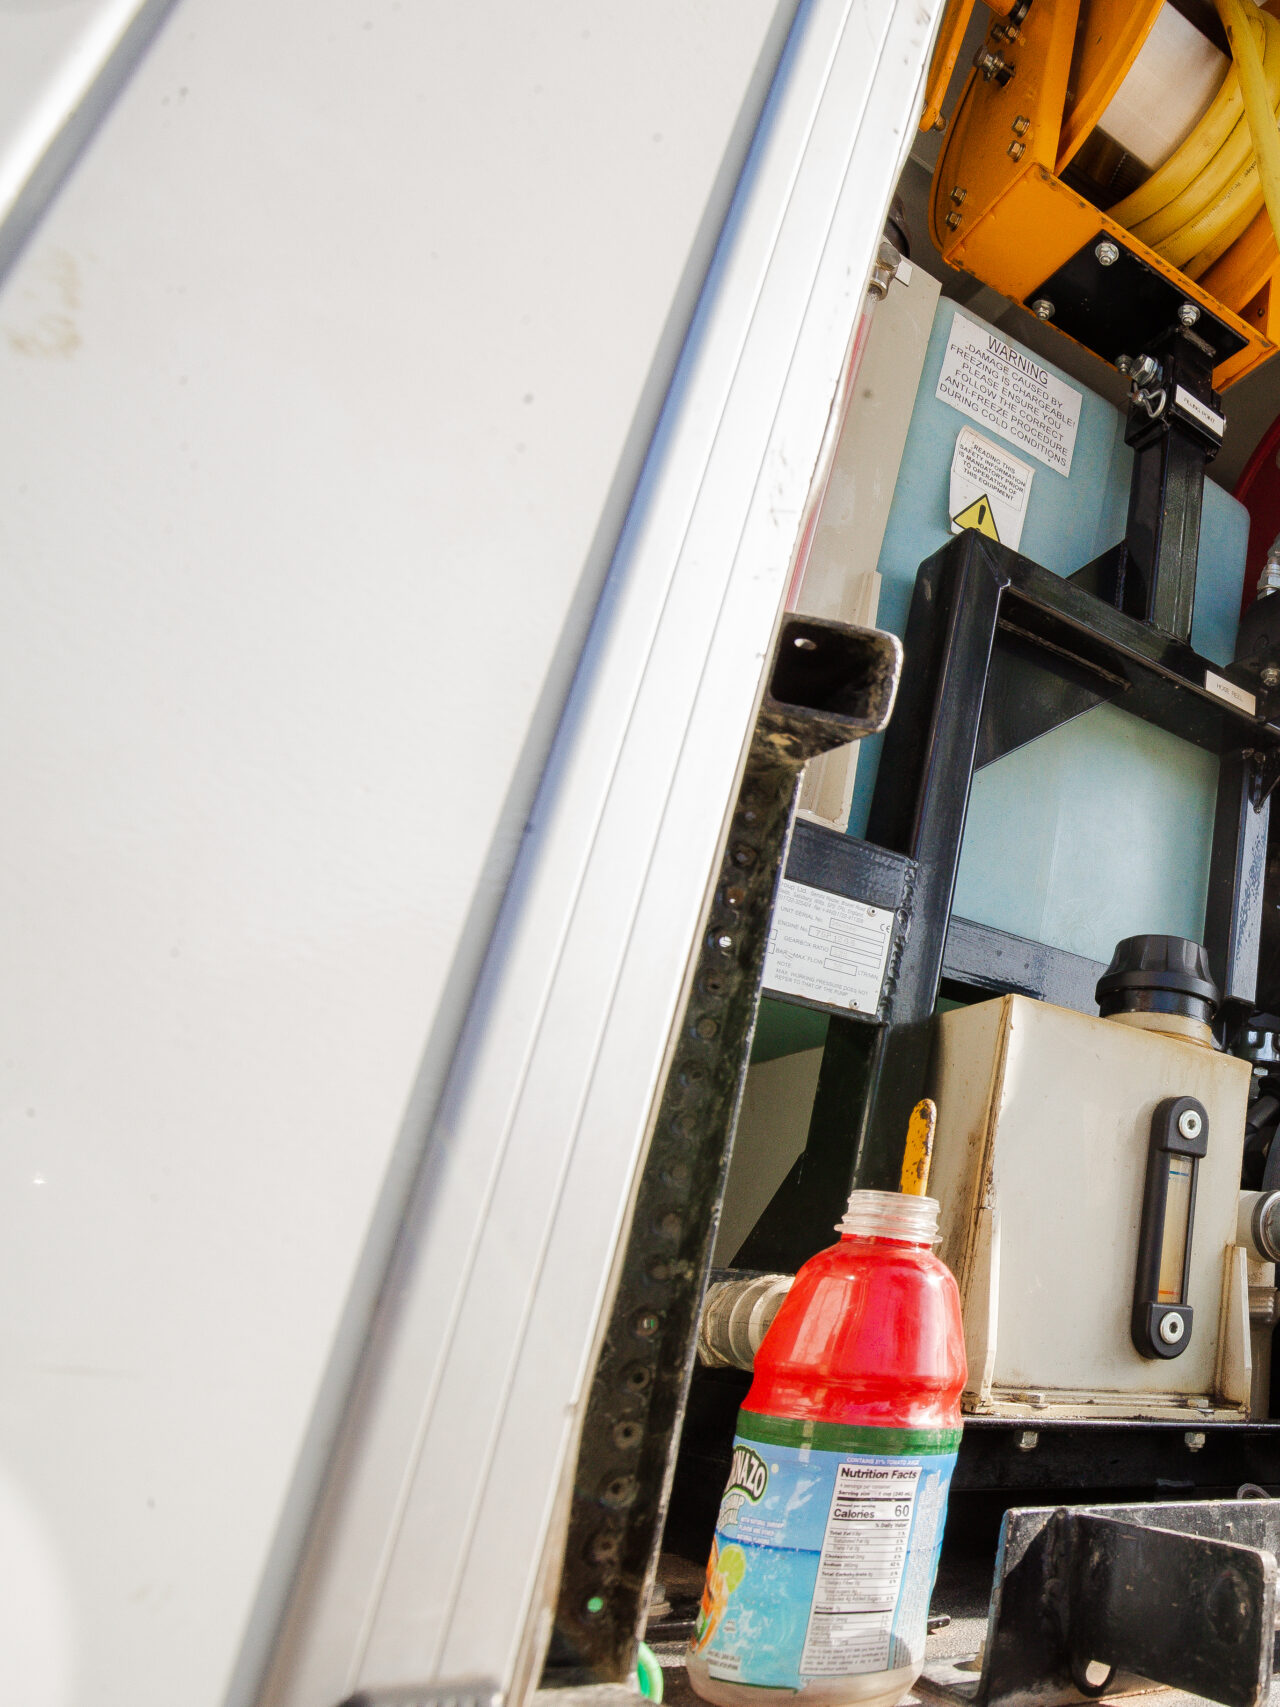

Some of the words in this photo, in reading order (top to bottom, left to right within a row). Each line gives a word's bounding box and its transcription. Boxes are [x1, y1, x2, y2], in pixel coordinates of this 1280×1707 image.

[950, 344, 998, 379] FREEZING
[1002, 376, 1010, 386] IS
[968, 344, 1009, 376] DAMAGE
[1012, 372, 1049, 400] CAUSED
[1051, 397, 1063, 408] BY
[988, 336, 1048, 385] WARNING
[945, 376, 1008, 419] ANTI-FREEZE
[1011, 415, 1068, 456] PROCEDURE
[956, 370, 996, 400] FOLLOW
[1000, 396, 1017, 414] THE
[1020, 410, 1064, 441] CORRECT
[962, 362, 1000, 390] PLEASE
[1002, 387, 1040, 416] ENSURE
[1042, 412, 1061, 430] YOU
[940, 383, 978, 412] DURING
[982, 408, 1008, 430] COLD
[1010, 426, 1066, 466] CONDITIONS
[960, 444, 984, 460] SAFETY
[984, 460, 1026, 487] INFORMATION
[963, 460, 972, 468] TO
[972, 466, 1008, 490] OPERATION
[966, 455, 1004, 480] MANDATORY
[1004, 478, 1024, 493] PRIOR
[974, 444, 1001, 465] READING
[1002, 462, 1016, 474] THIS
[964, 468, 978, 480] THIS
[978, 477, 1014, 500] EQUIPMENT
[840, 1467, 888, 1479] Nutrition
[890, 1470, 918, 1479] Facts
[834, 1508, 875, 1518] Calories
[894, 1504, 910, 1517] 60
